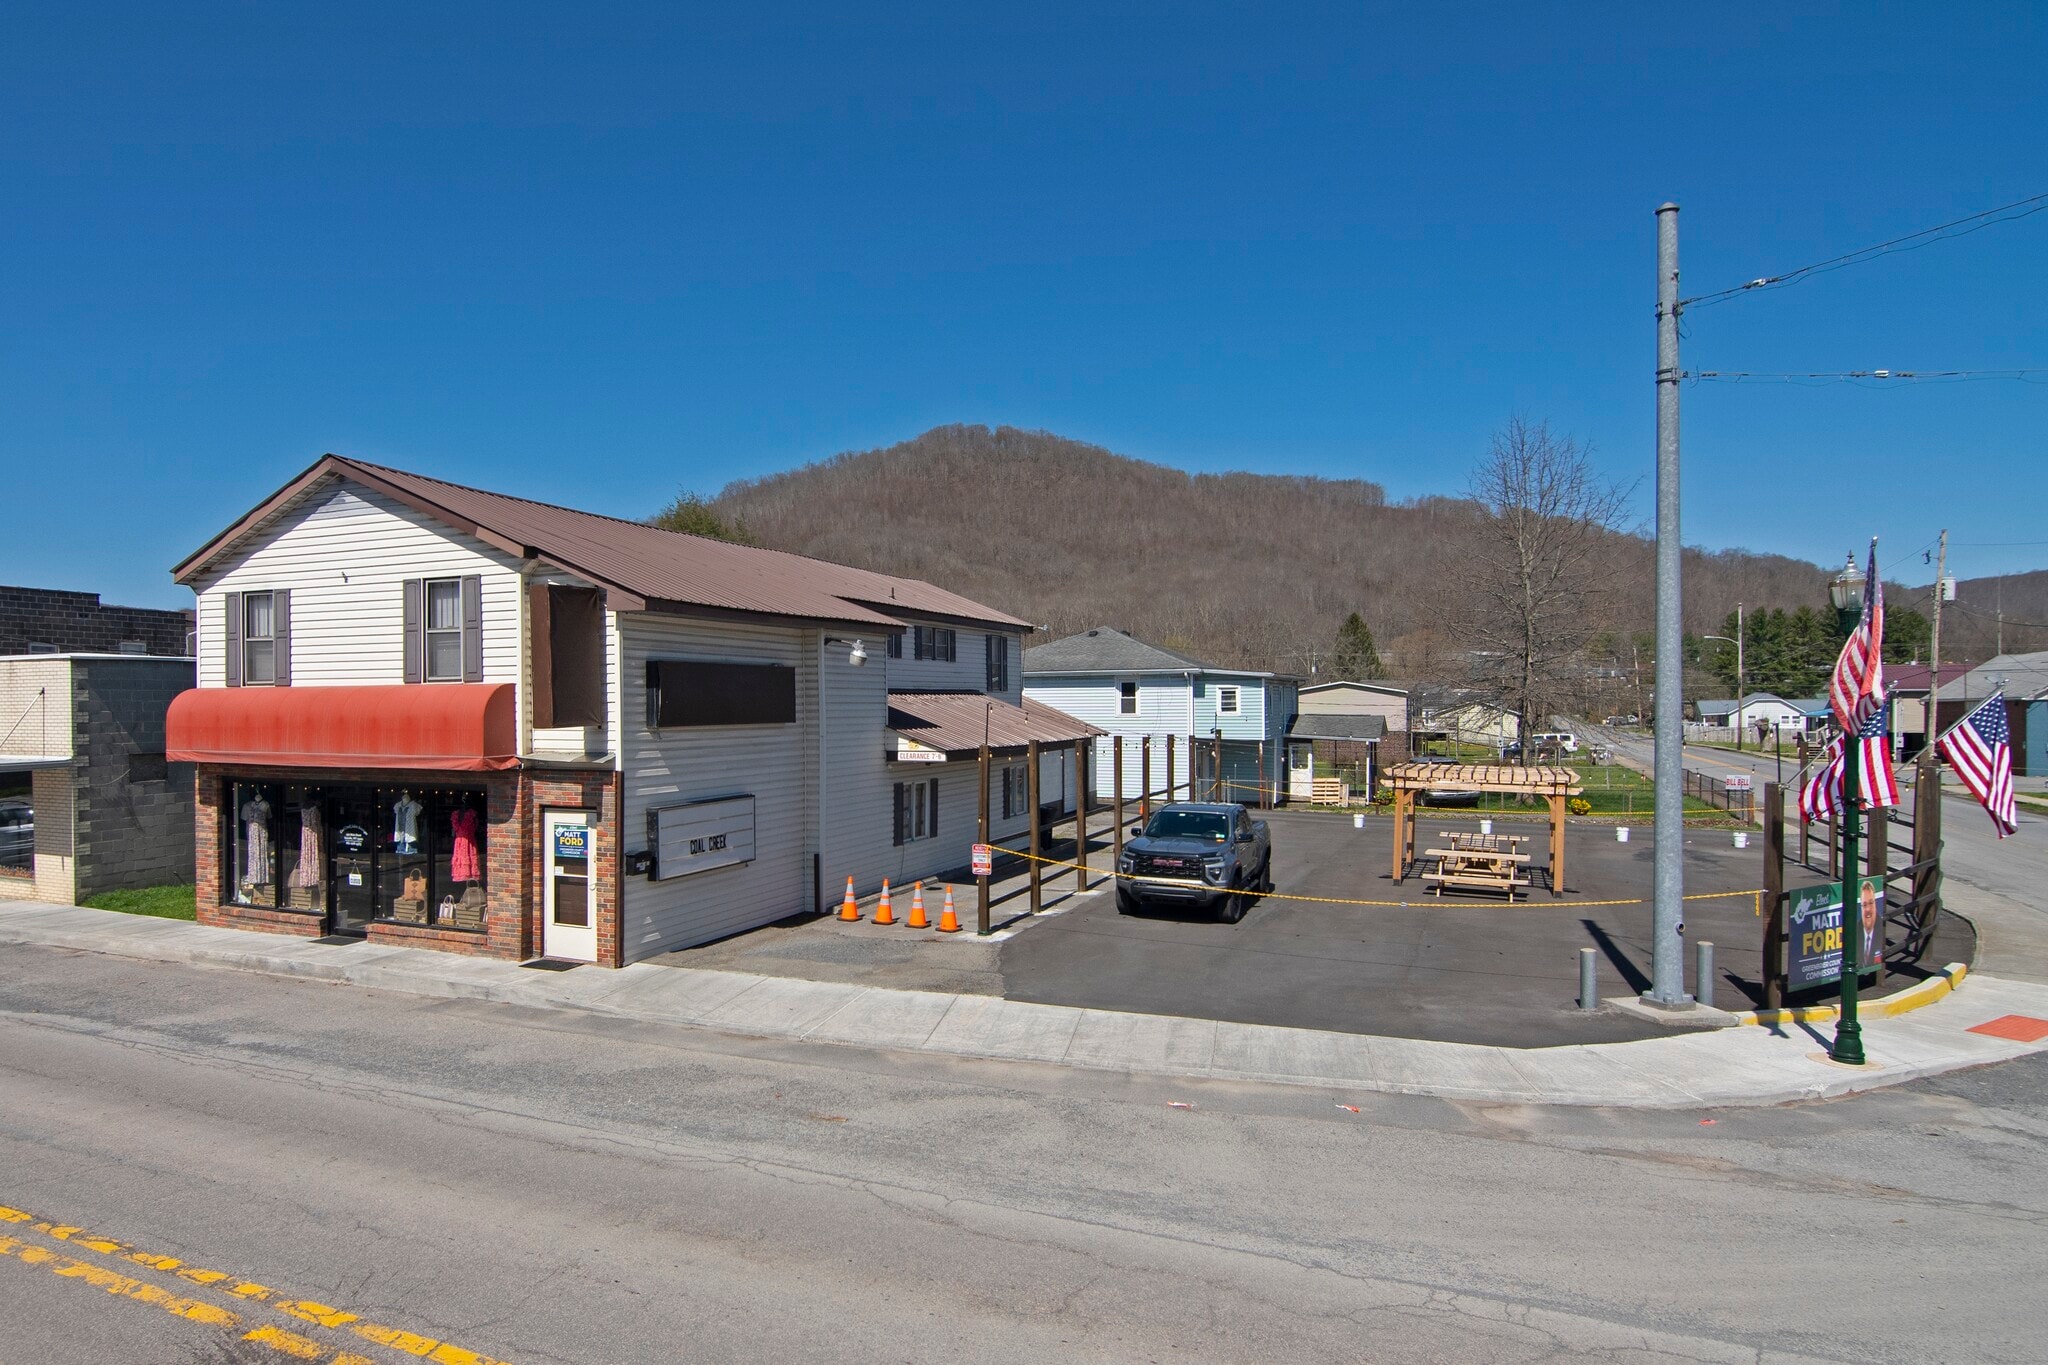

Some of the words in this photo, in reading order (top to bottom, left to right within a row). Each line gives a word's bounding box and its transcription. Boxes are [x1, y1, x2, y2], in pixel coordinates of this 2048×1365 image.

[899, 752, 930, 760] CLEARANCE
[1726, 778, 1736, 786] BILL
[1737, 778, 1749, 786] BELL
[560, 837, 583, 846] FORD
[690, 838, 705, 855] COAL
[708, 834, 727, 851] CREEK
[1816, 893, 1829, 906] Elect
[1812, 911, 1841, 930] MATT
